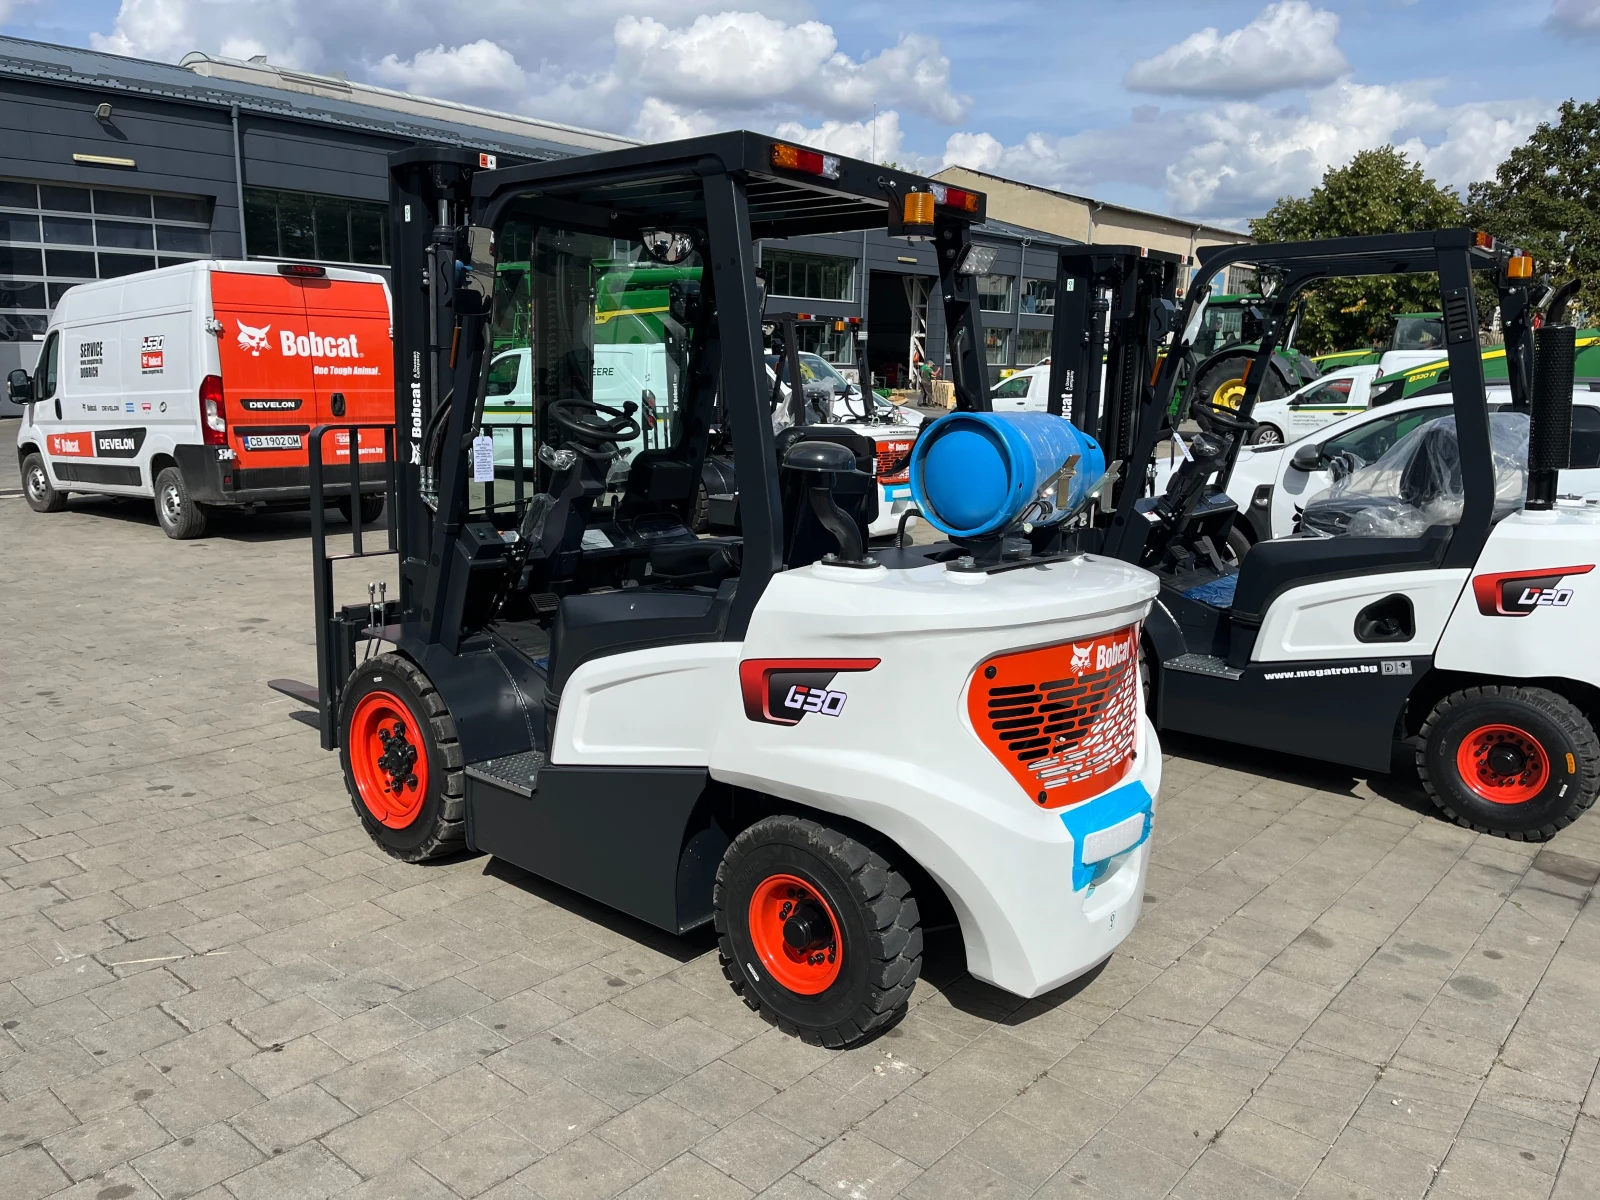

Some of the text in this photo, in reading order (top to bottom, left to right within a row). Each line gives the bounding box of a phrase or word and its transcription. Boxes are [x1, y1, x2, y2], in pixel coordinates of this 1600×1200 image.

[80, 341, 103, 358] SERVICE
[280, 331, 359, 358] Bobcat
[148, 355, 162, 366] Bobcat
[80, 366, 99, 378] DOBRICH
[313, 365, 329, 375] One
[330, 366, 353, 376] Tough
[593, 367, 614, 376] EERE
[249, 401, 296, 409] DEVELON
[411, 382, 422, 438] Bobcat
[1060, 393, 1073, 423] bcat
[62, 439, 80, 453] Bobcat
[99, 438, 135, 450] DEVELON
[250, 436, 300, 447] CB 1902 OM
[895, 443, 910, 451] Bobcat
[1517, 588, 1575, 607] D20
[1095, 636, 1131, 671] Bobcat
[1263, 664, 1378, 681] www.megatron.bg
[783, 683, 848, 718] G30
